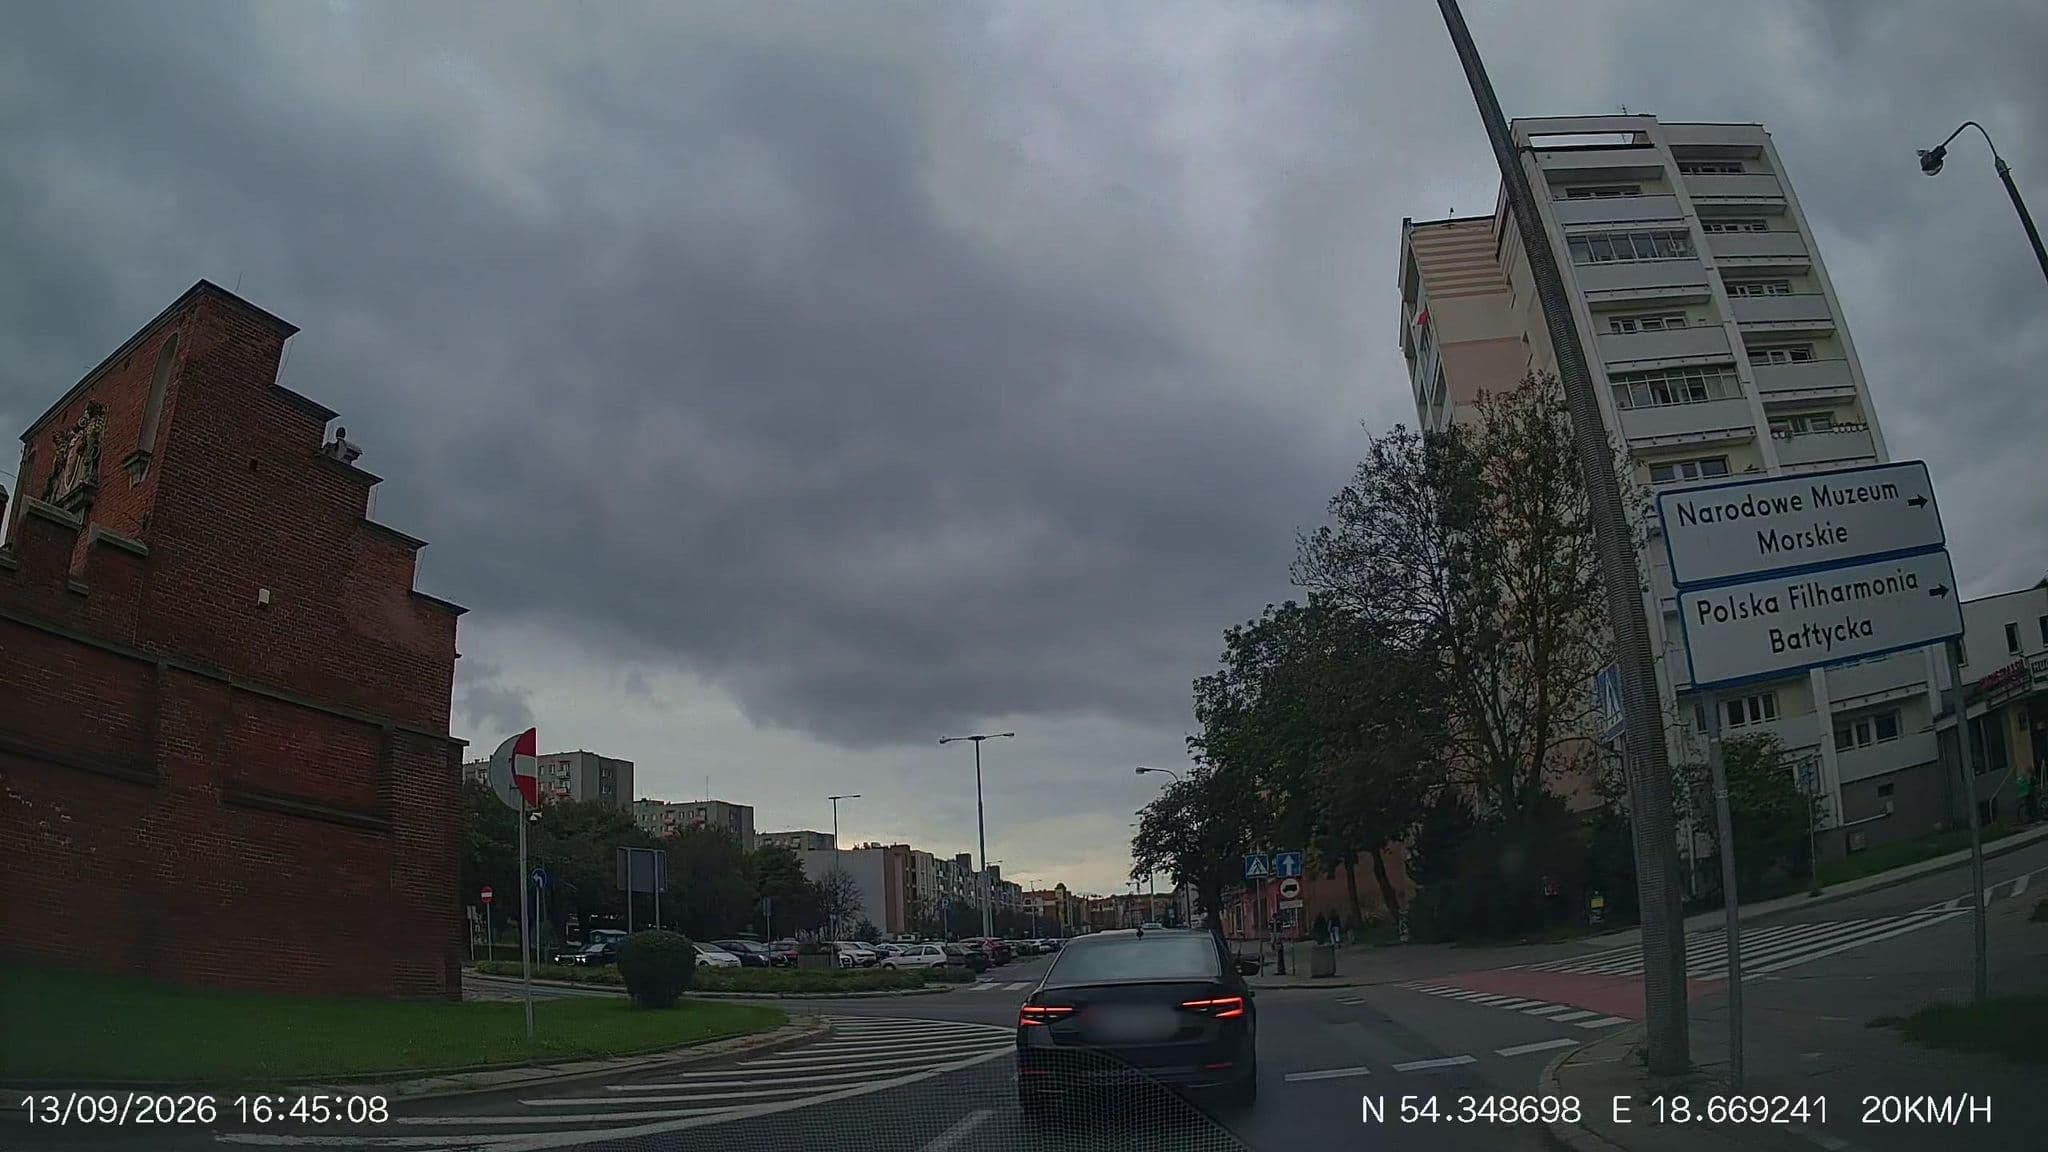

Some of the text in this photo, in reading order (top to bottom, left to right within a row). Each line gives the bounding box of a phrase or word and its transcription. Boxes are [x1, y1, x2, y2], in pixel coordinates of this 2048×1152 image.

[1677, 483, 1899, 527] Narodowe Muzeum
[1757, 521, 1848, 555] Morskie
[1696, 568, 1919, 626] Polska Filharmonia
[1768, 616, 1874, 654] Bałtycka
